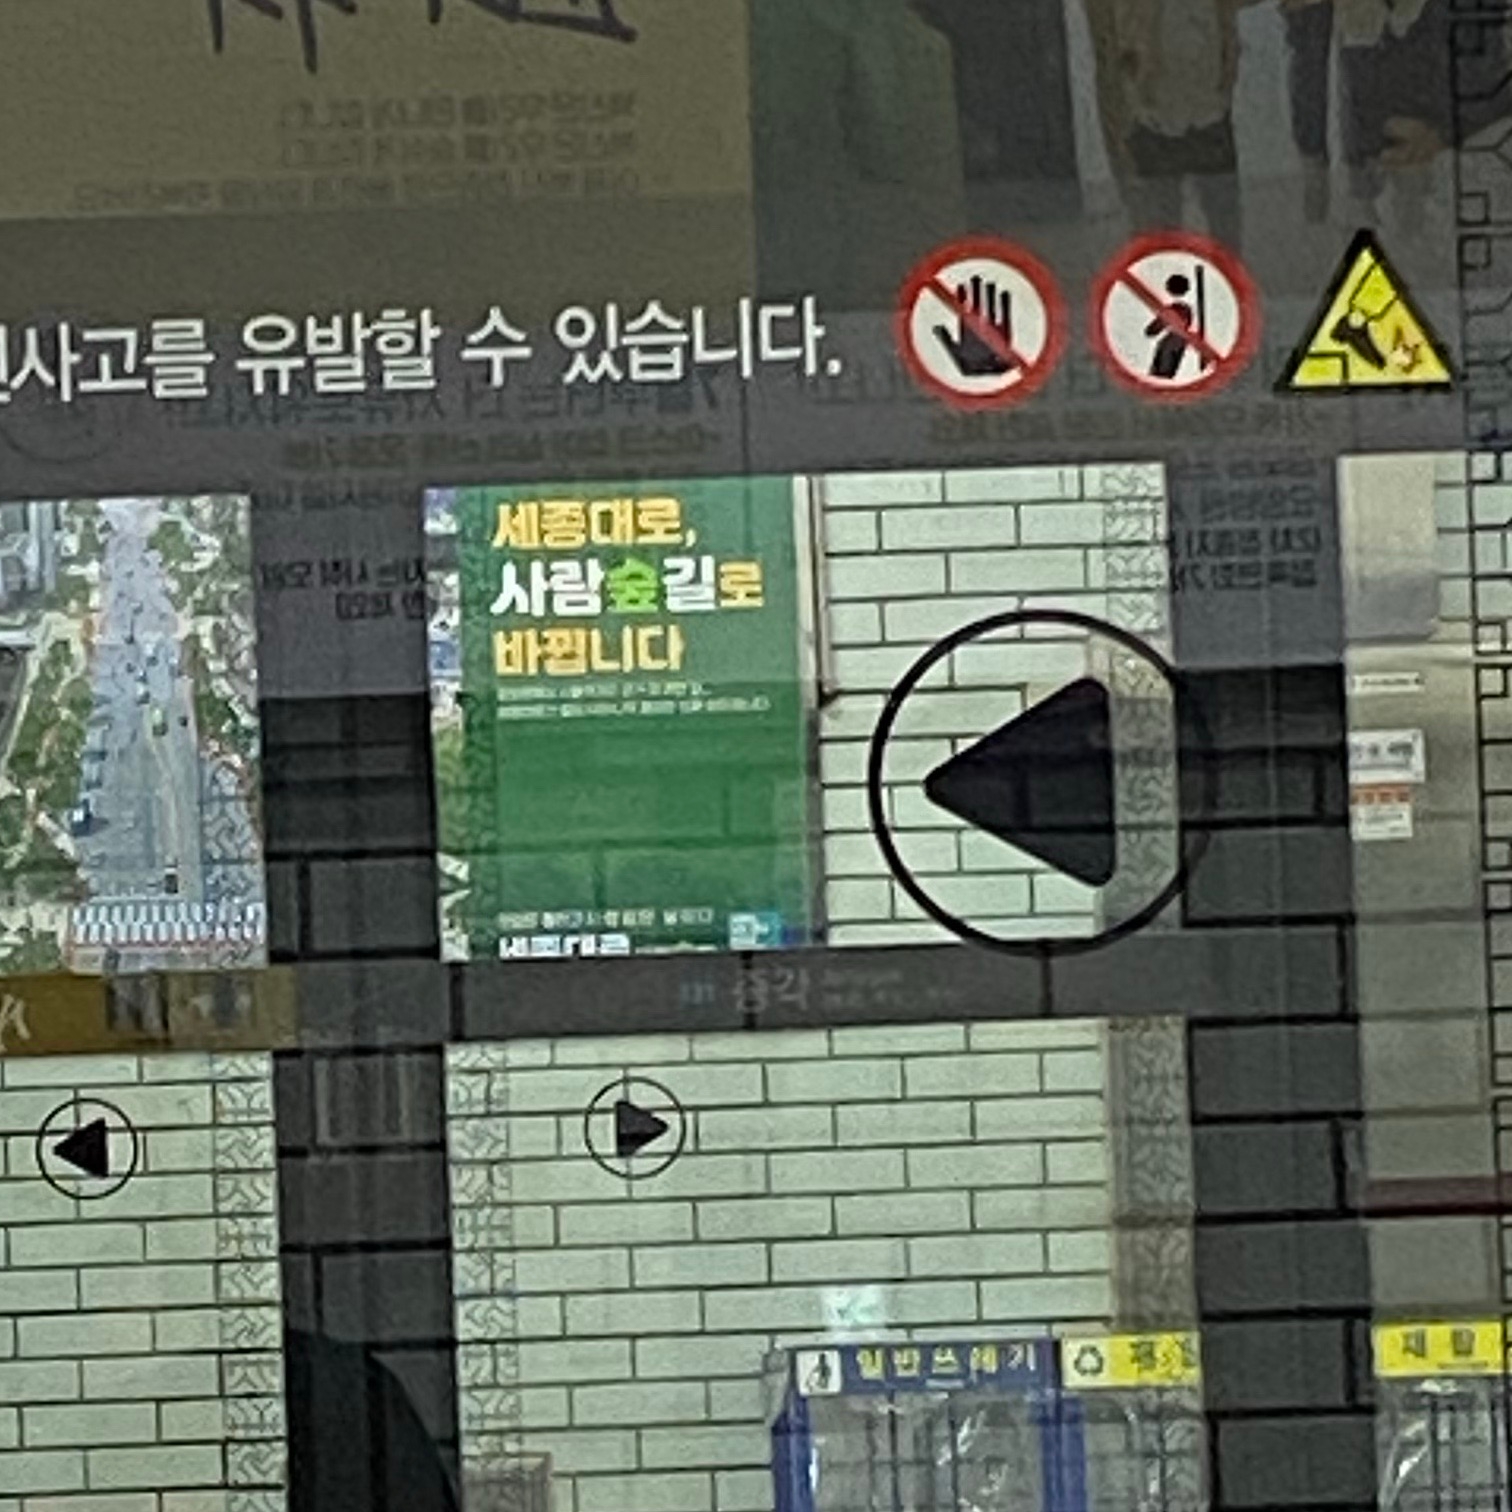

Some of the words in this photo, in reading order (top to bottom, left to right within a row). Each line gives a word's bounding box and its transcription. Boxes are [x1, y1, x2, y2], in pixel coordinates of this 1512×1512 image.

[235, 308, 442, 397] 유발할
[460, 305, 533, 389] 수
[555, 294, 842, 386] 있습니다.
[492, 497, 698, 550] 세종대로,
[490, 555, 765, 617] 사람숲길로
